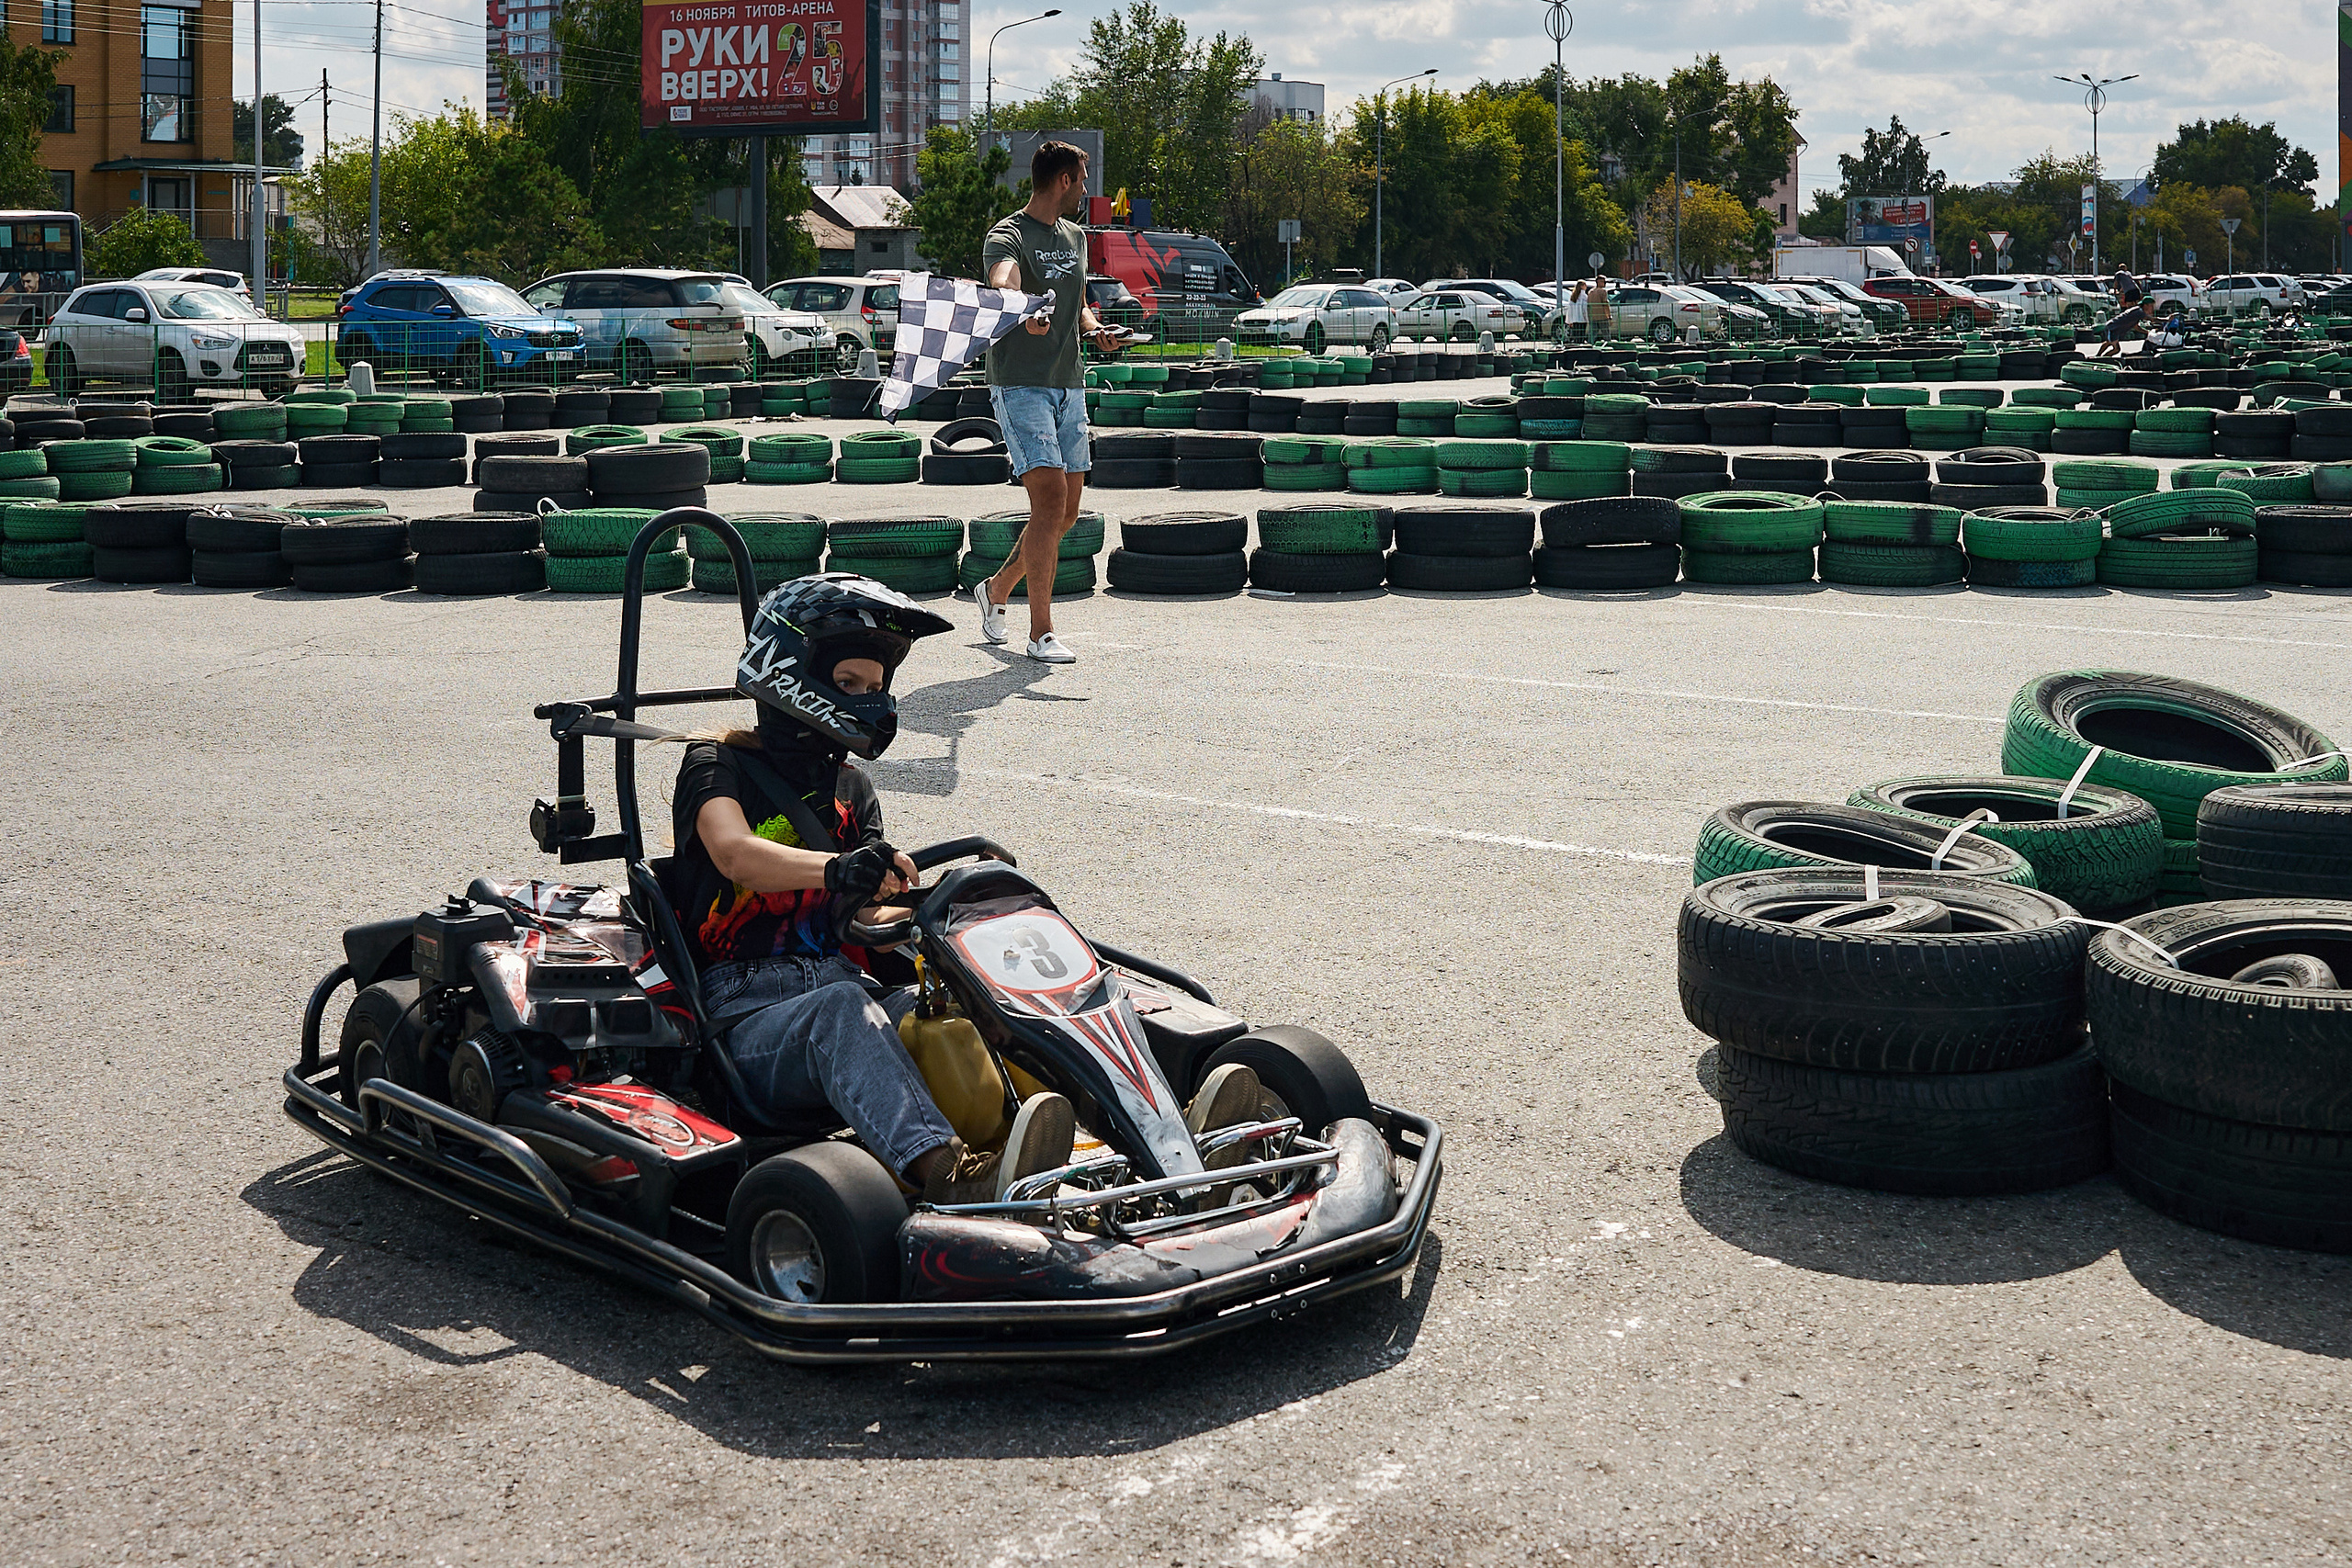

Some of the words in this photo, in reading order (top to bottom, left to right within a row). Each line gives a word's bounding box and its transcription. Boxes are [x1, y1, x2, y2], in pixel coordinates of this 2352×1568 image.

[669, 10, 683, 23] 16
[686, 6, 735, 21] НОЯБРЯ
[745, 2, 834, 17] ТИТОВ-АРЕНА
[661, 24, 769, 69] РУКИ
[777, 21, 844, 96] 25
[1035, 248, 1080, 262] Reebok
[1012, 927, 1069, 979] 3
